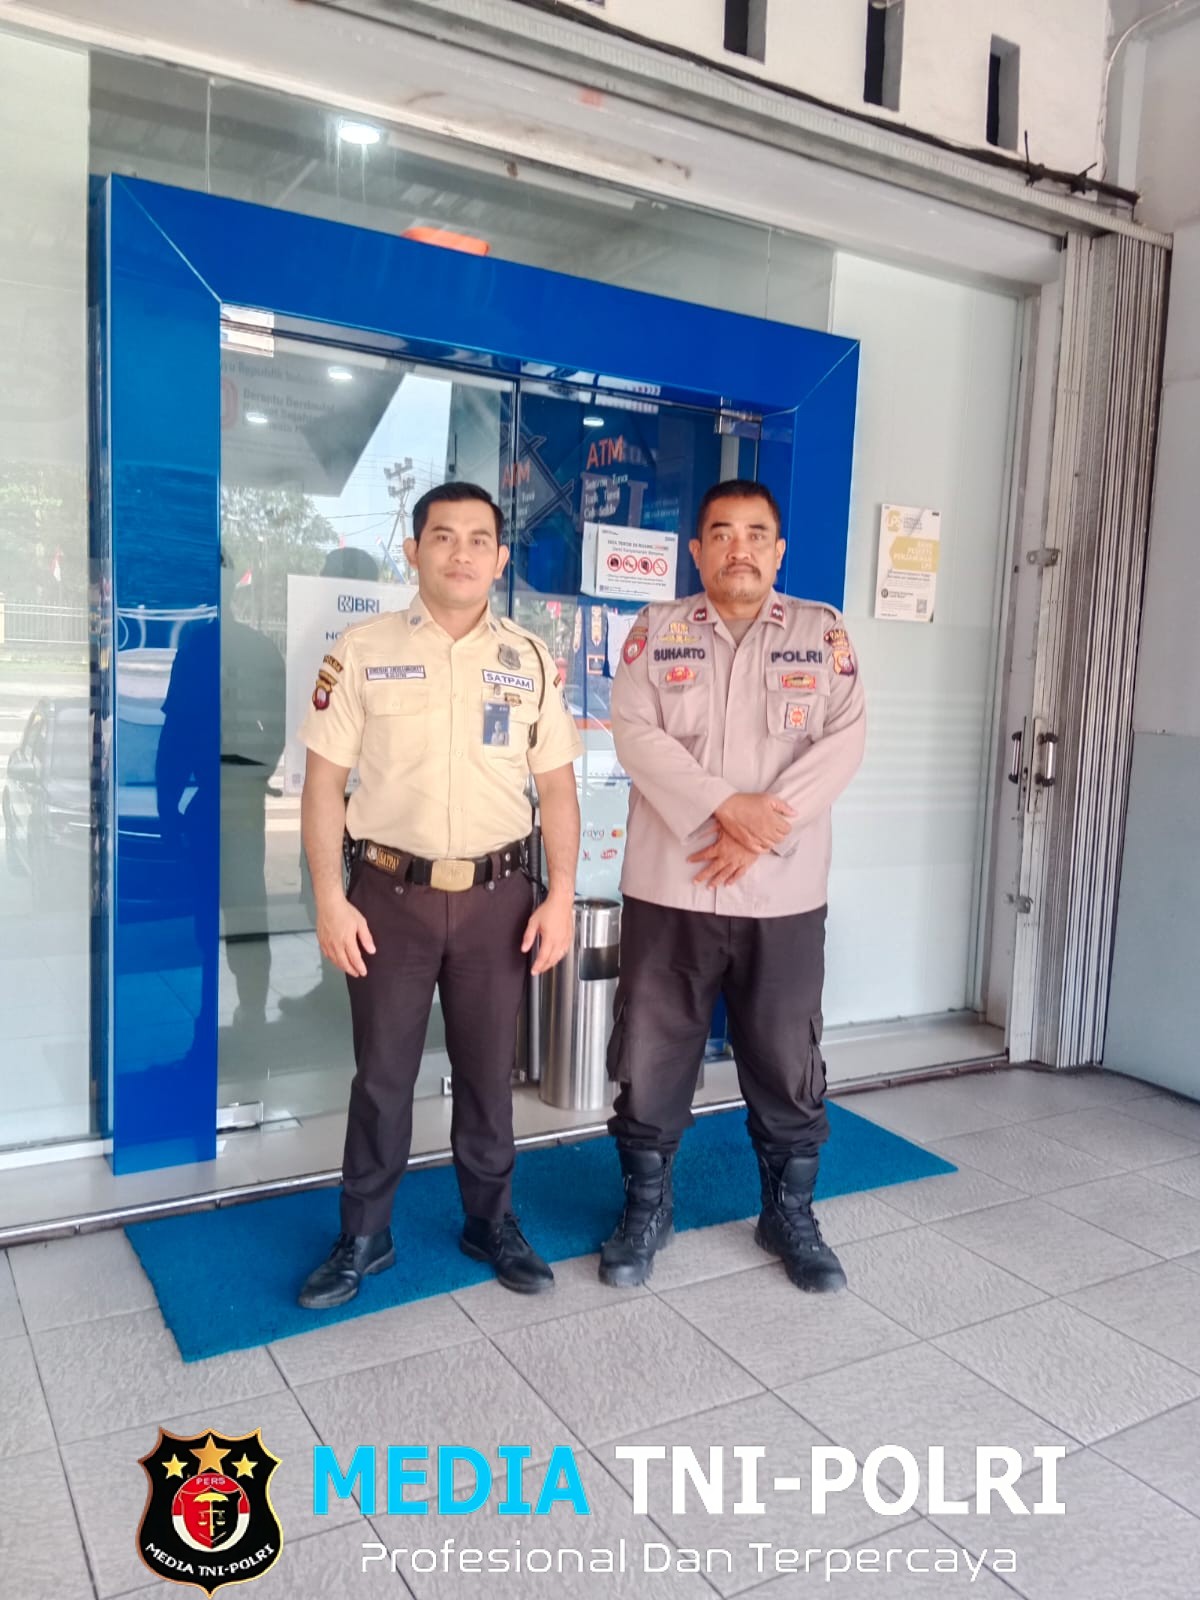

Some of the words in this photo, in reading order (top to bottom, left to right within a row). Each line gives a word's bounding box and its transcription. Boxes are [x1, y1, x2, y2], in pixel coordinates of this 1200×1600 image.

[586, 435, 625, 470] ATM
[355, 598, 380, 613] BRI
[771, 651, 822, 664] POLRI
[486, 673, 530, 688] SATPAM
